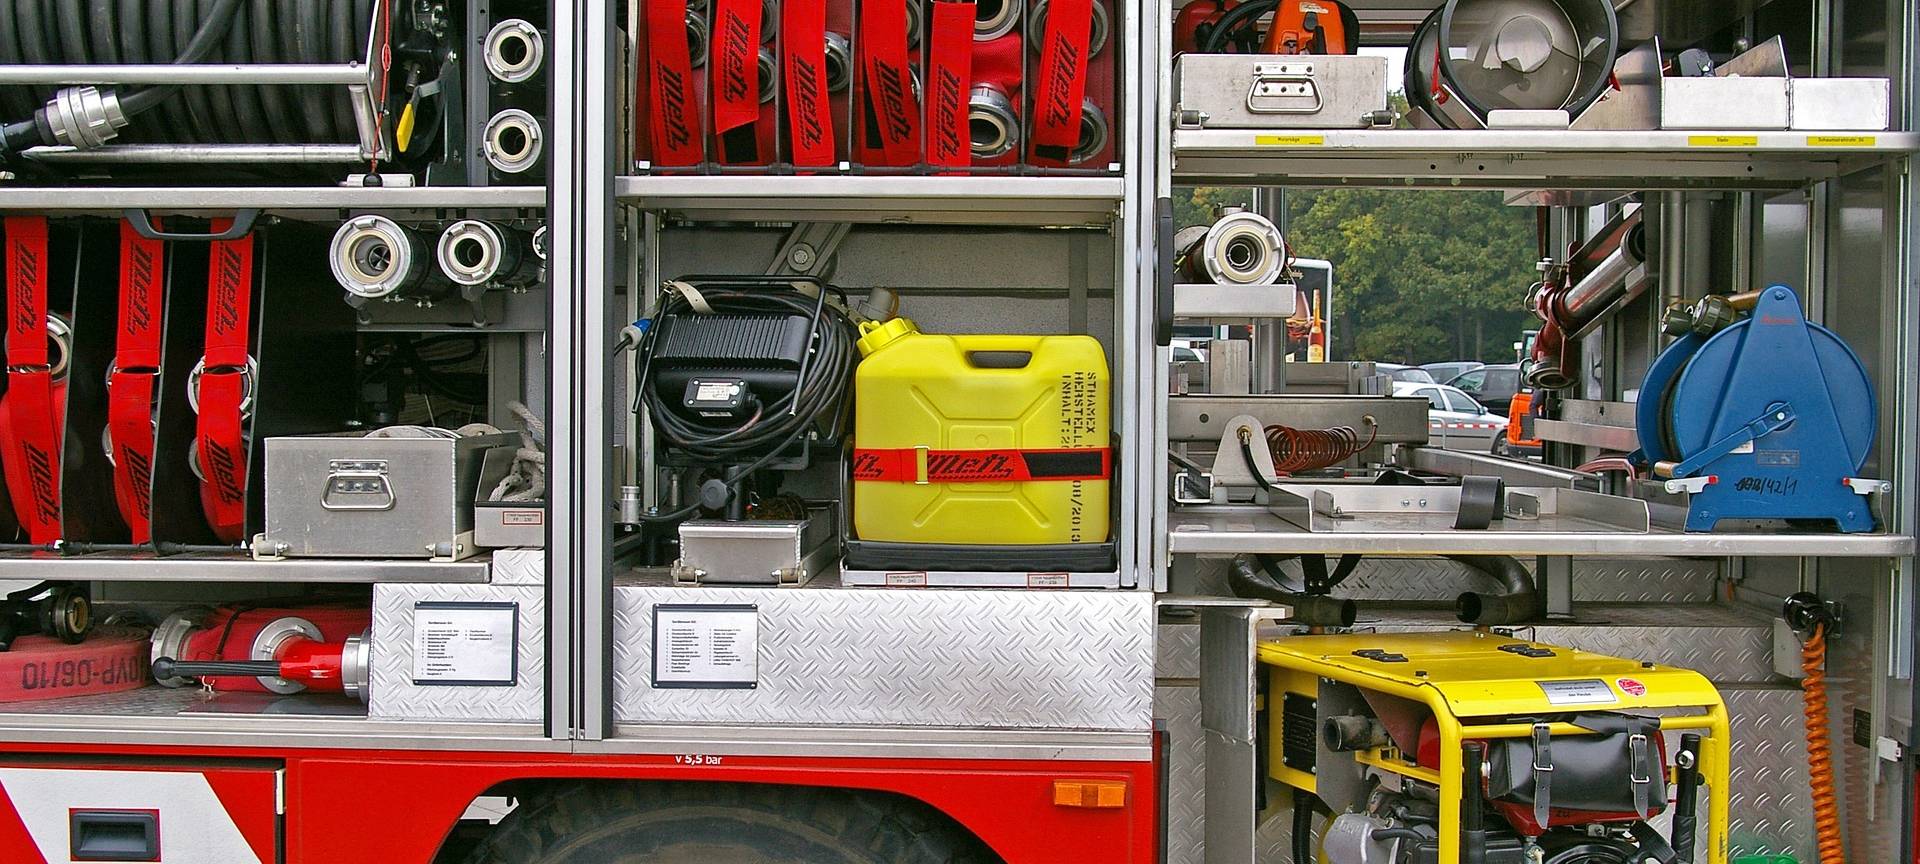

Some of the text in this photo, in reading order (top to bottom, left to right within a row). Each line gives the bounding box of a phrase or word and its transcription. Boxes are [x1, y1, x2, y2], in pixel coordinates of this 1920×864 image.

[1086, 371, 1097, 434] STHAMEX
[684, 754, 703, 766] 5,5
[705, 755, 723, 765] bar
